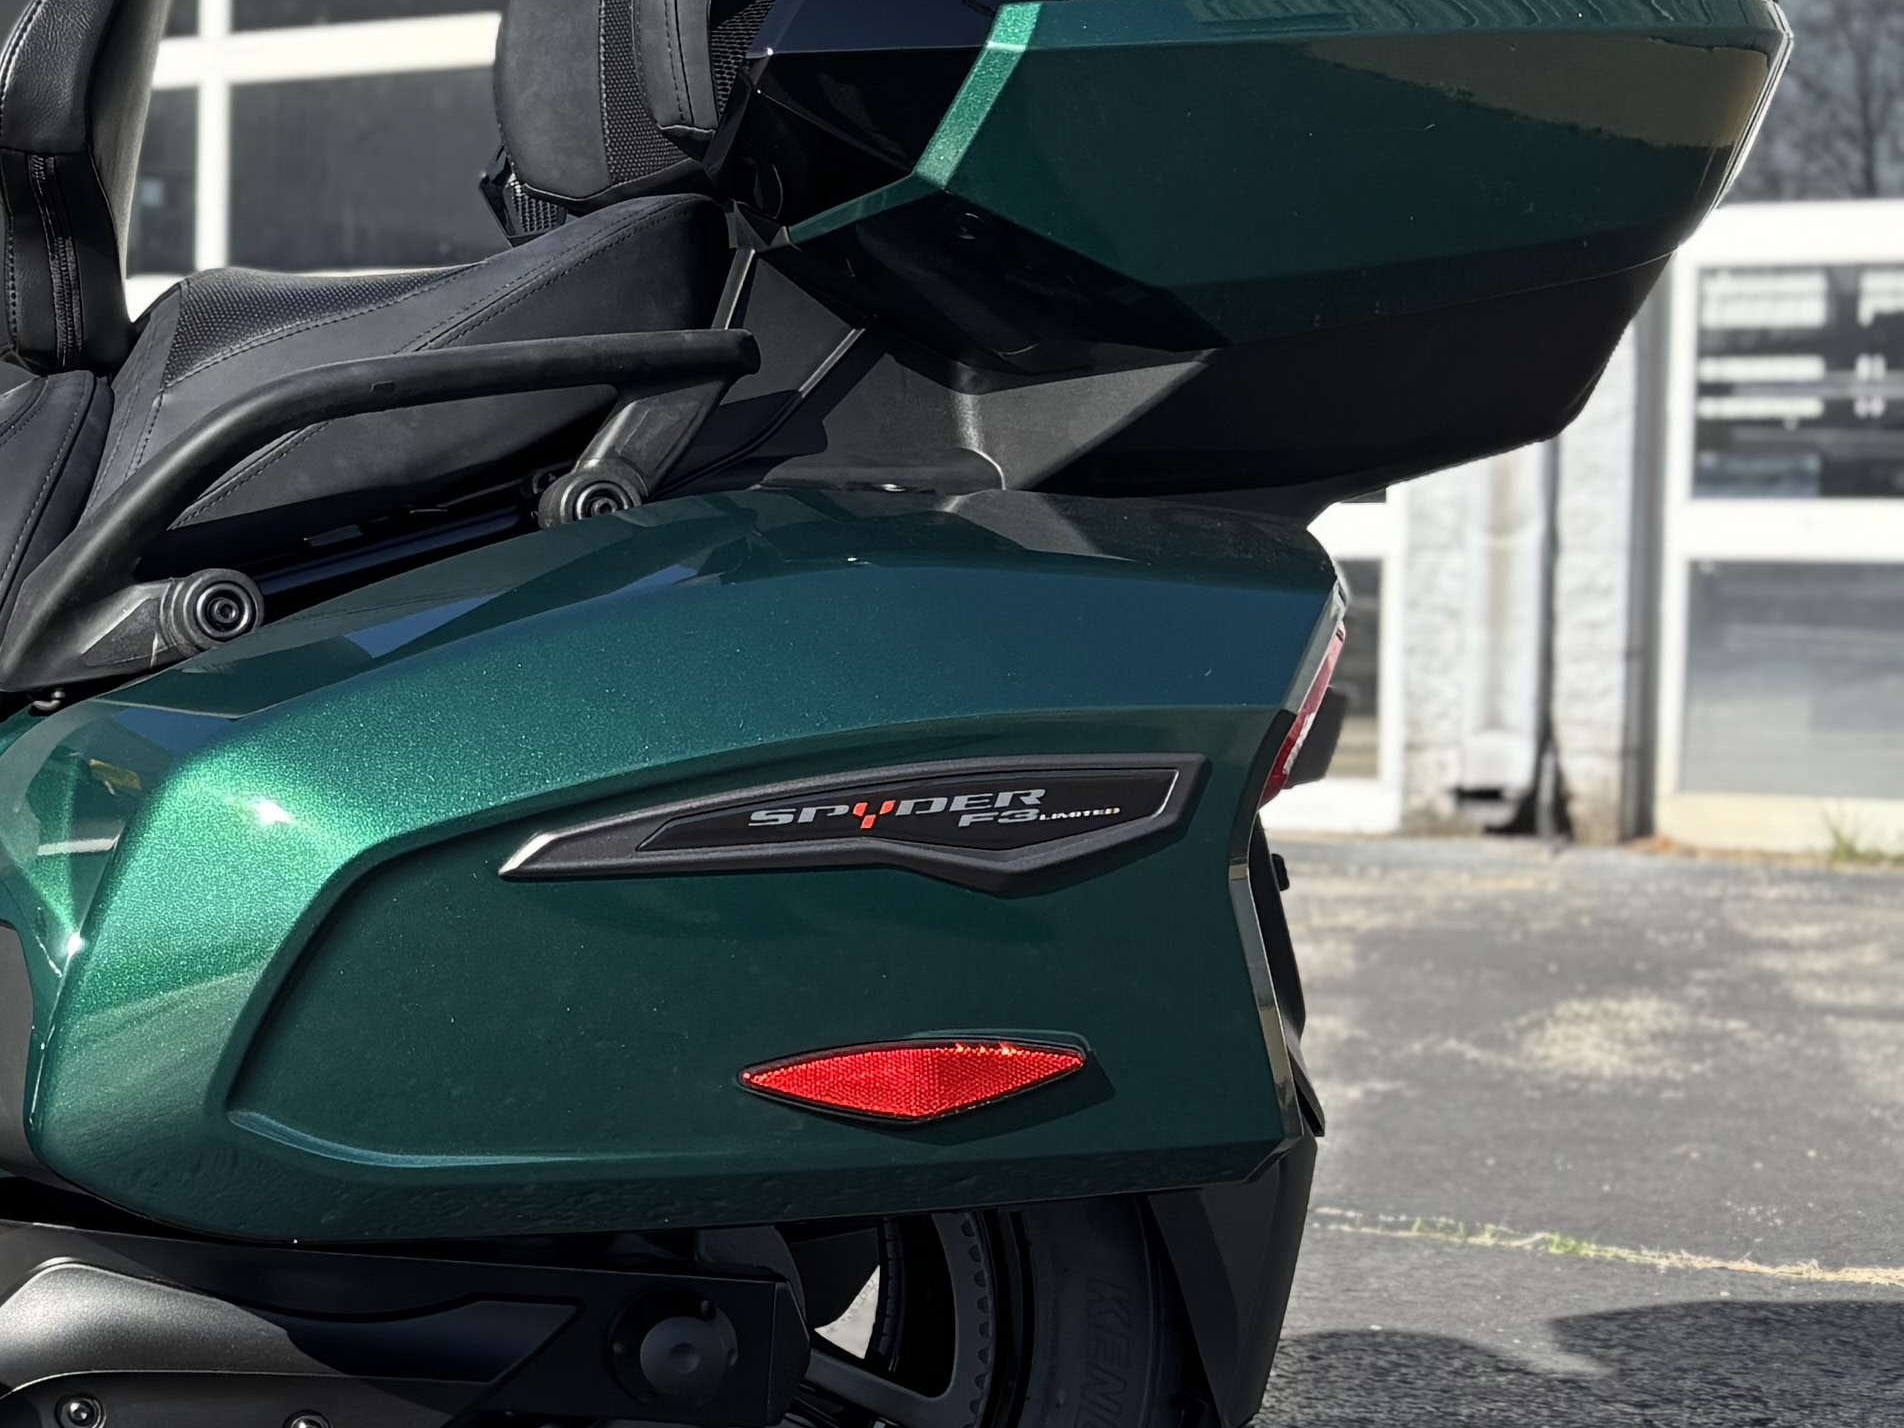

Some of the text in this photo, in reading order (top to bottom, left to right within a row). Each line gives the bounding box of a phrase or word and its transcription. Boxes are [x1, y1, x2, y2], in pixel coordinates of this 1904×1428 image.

[748, 788, 1046, 829] SPYDER
[958, 806, 1121, 827] F3 LIMITED
